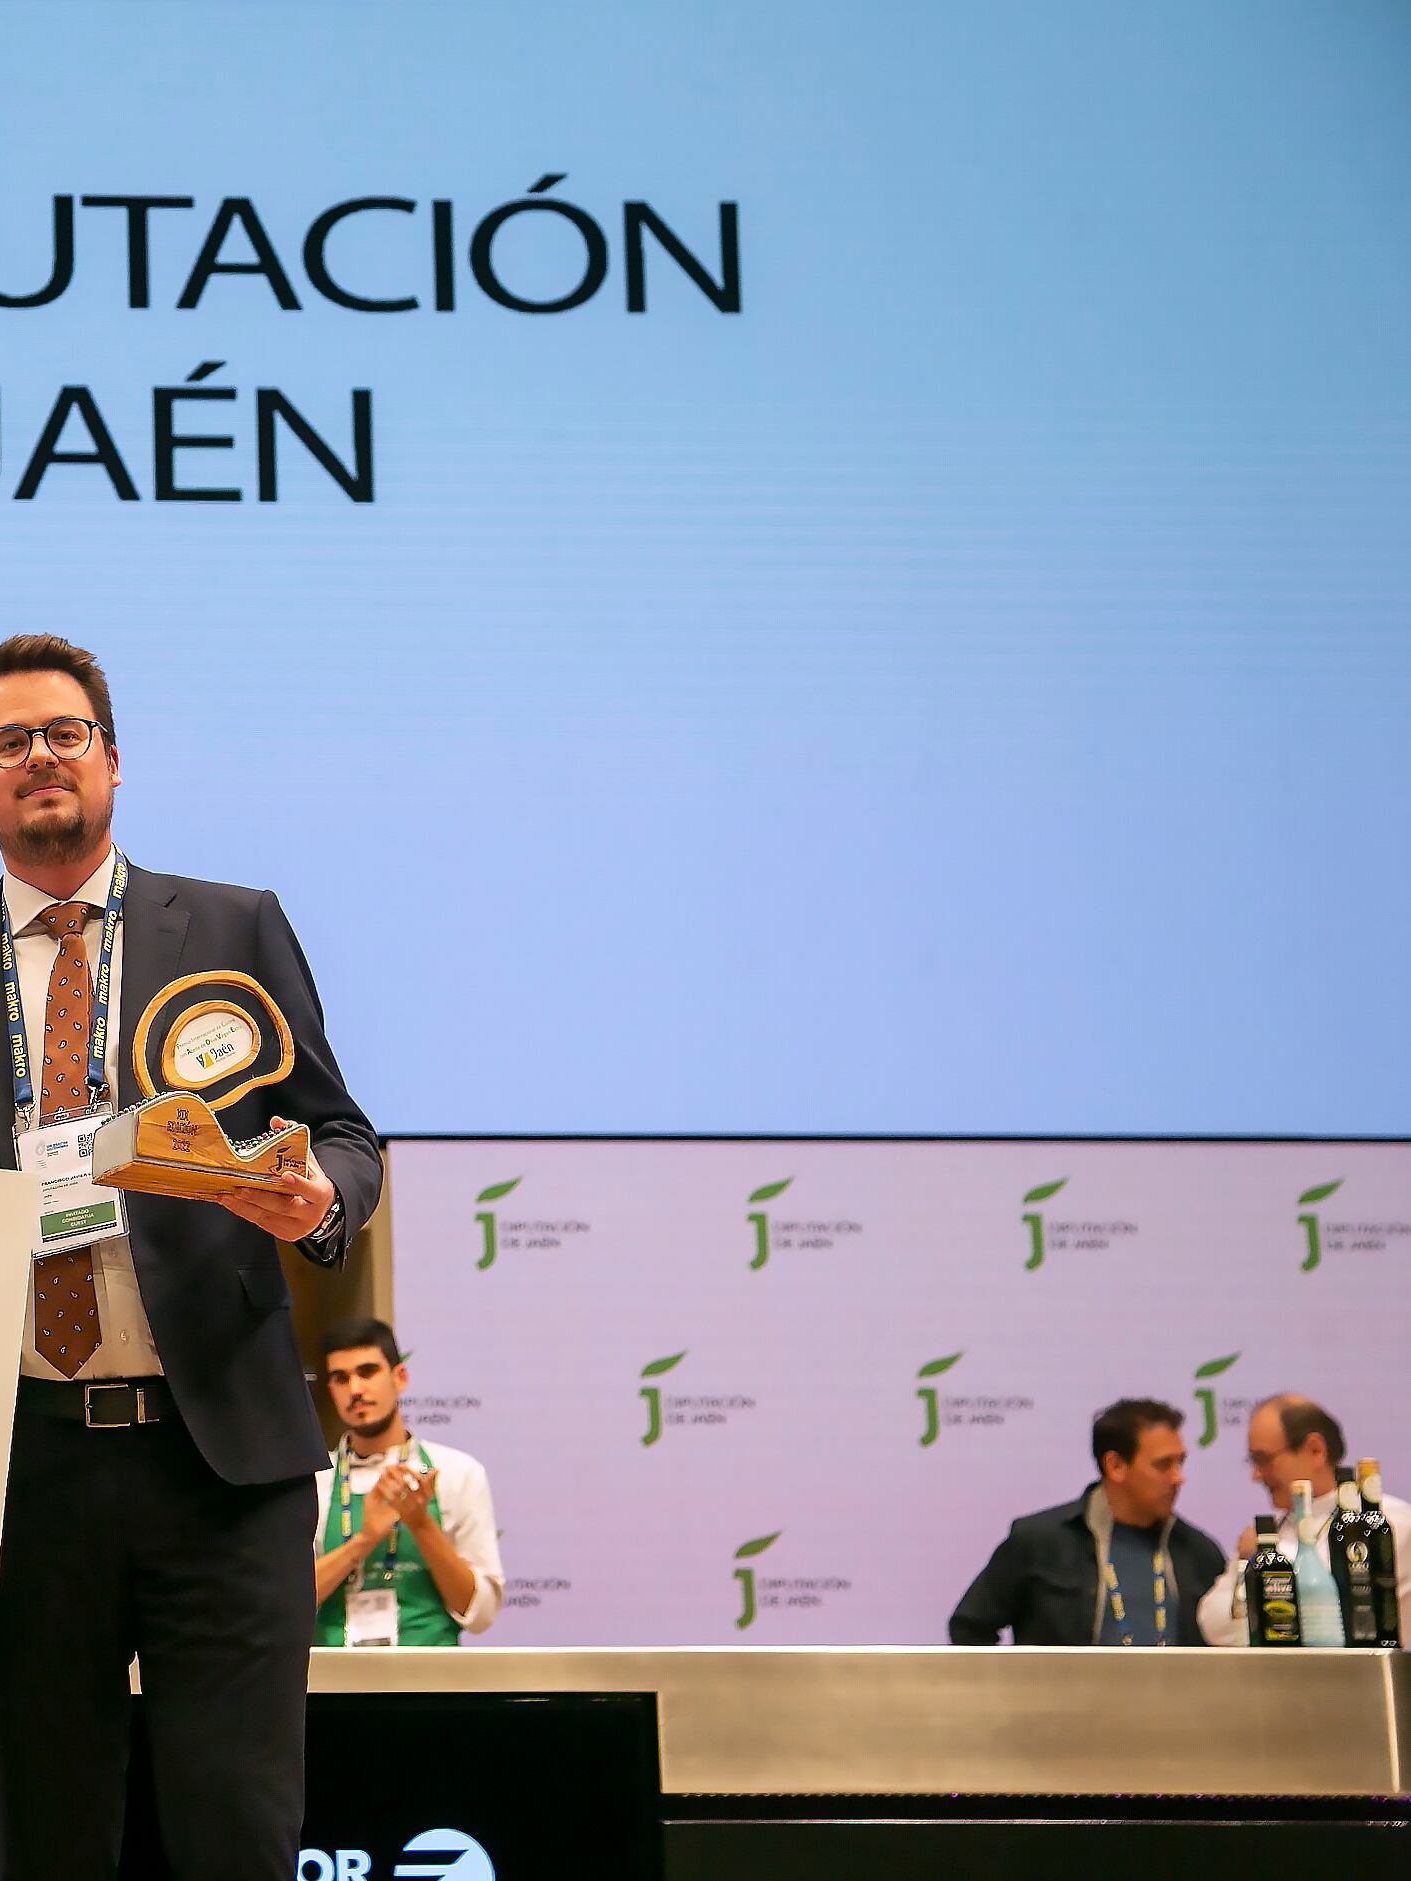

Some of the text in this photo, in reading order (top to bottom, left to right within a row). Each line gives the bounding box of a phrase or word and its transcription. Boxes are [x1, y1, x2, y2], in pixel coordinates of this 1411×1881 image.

[112, 862, 125, 899] makro
[1, 933, 13, 971] makro
[103, 910, 117, 953] makro
[5, 981, 20, 1022] makro
[98, 963, 110, 1005] makro
[12, 1034, 26, 1078] makro
[93, 1016, 105, 1059] makro
[210, 1043, 235, 1060] Jaén
